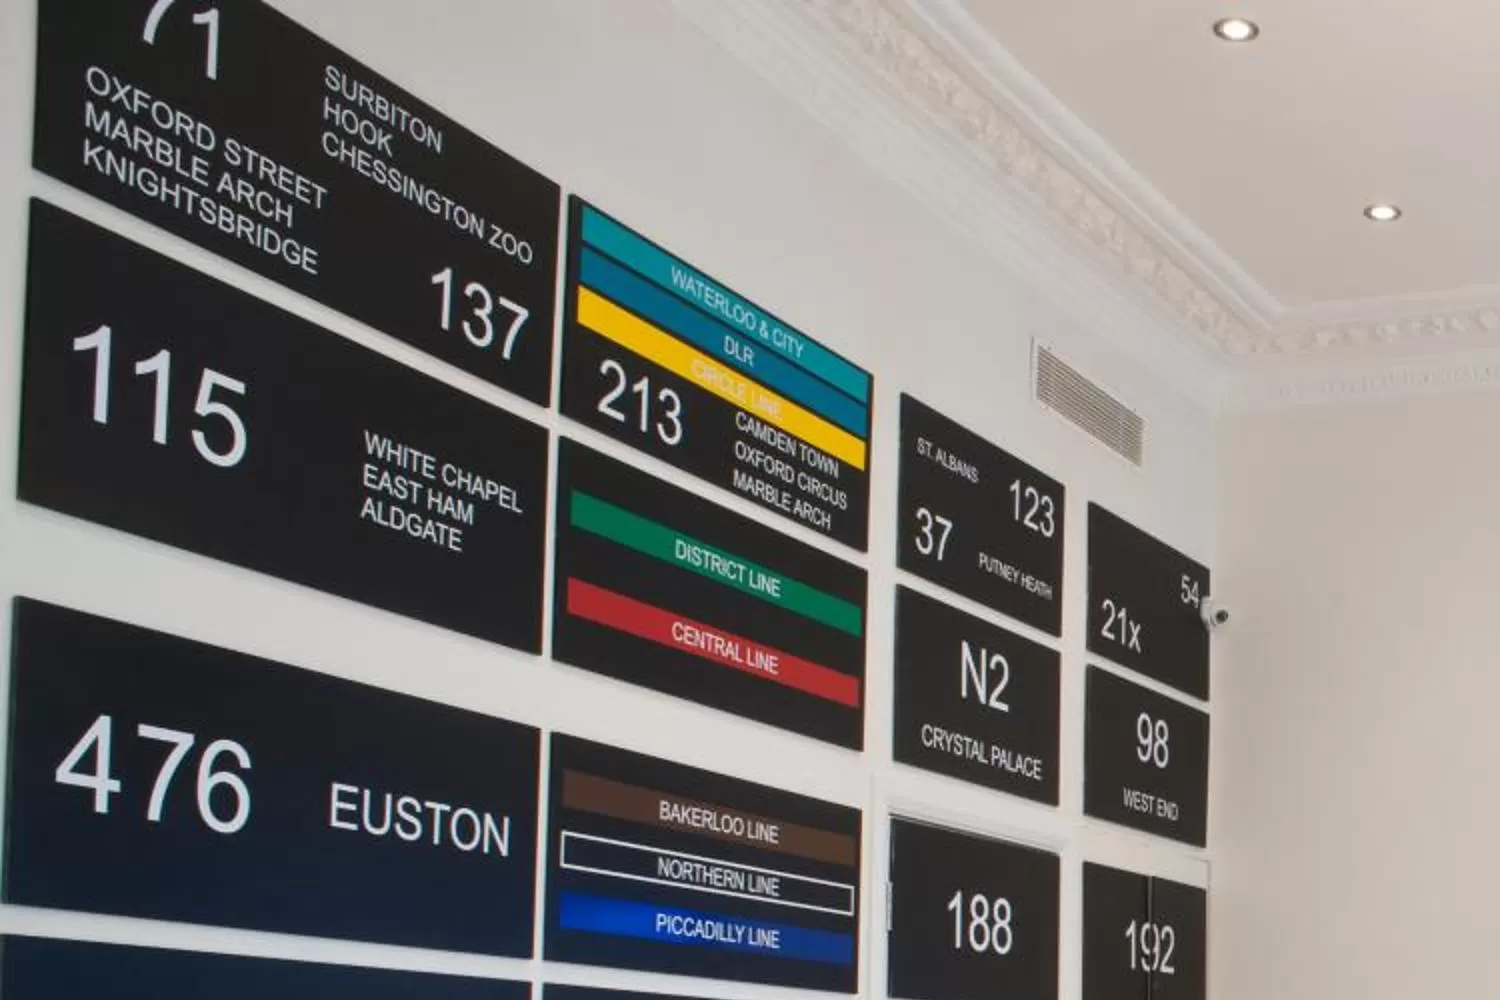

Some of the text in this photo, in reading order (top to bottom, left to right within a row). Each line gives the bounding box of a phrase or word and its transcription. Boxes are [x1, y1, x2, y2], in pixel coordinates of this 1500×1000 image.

[86, 66, 327, 209] OXFORD STREET
[323, 97, 393, 156] HOOK
[325, 66, 442, 153] SURBITON
[86, 103, 294, 228] MARBLE ARCH
[83, 140, 319, 275] KNIGHTSBRIDGE
[322, 131, 533, 265] CHESSINGTON ZOO
[430, 267, 529, 360] 137
[672, 265, 804, 358] WATERLOO & CITY
[724, 335, 754, 367] DLR
[73, 325, 246, 468] 115
[597, 359, 682, 445] 213
[691, 358, 781, 416] CIRCLE LINE
[365, 430, 523, 514] WHITE CHAPEL
[735, 411, 838, 478] CAMDEN TOWN
[936, 449, 979, 484] ALBANS
[363, 465, 474, 525] EAST HAM
[733, 469, 831, 530] MARBLE ARCH
[734, 442, 847, 510] OXFORD CIRCUS
[361, 499, 463, 552] ALDGATE
[915, 508, 953, 561] 37
[1010, 480, 1055, 538] 123
[675, 538, 780, 598] DISTRICT LINE
[979, 552, 1052, 601] PUTNEY HEATH
[672, 620, 778, 675] CENTRAL LINE
[1101, 599, 1141, 653] 21x
[961, 640, 1010, 712] N2
[922, 724, 1042, 781] CRYSTAL PALACE
[1137, 713, 1169, 769] 98
[55, 715, 251, 833] 476
[1124, 787, 1179, 821] WEST END
[330, 783, 509, 856] EUSTON
[659, 800, 779, 844] BAKERLOO LINE
[657, 857, 780, 897] NORTHERN LINE
[656, 914, 780, 949] PICCADILLY LINE
[948, 891, 1012, 955] 188
[1125, 920, 1174, 974] 192
